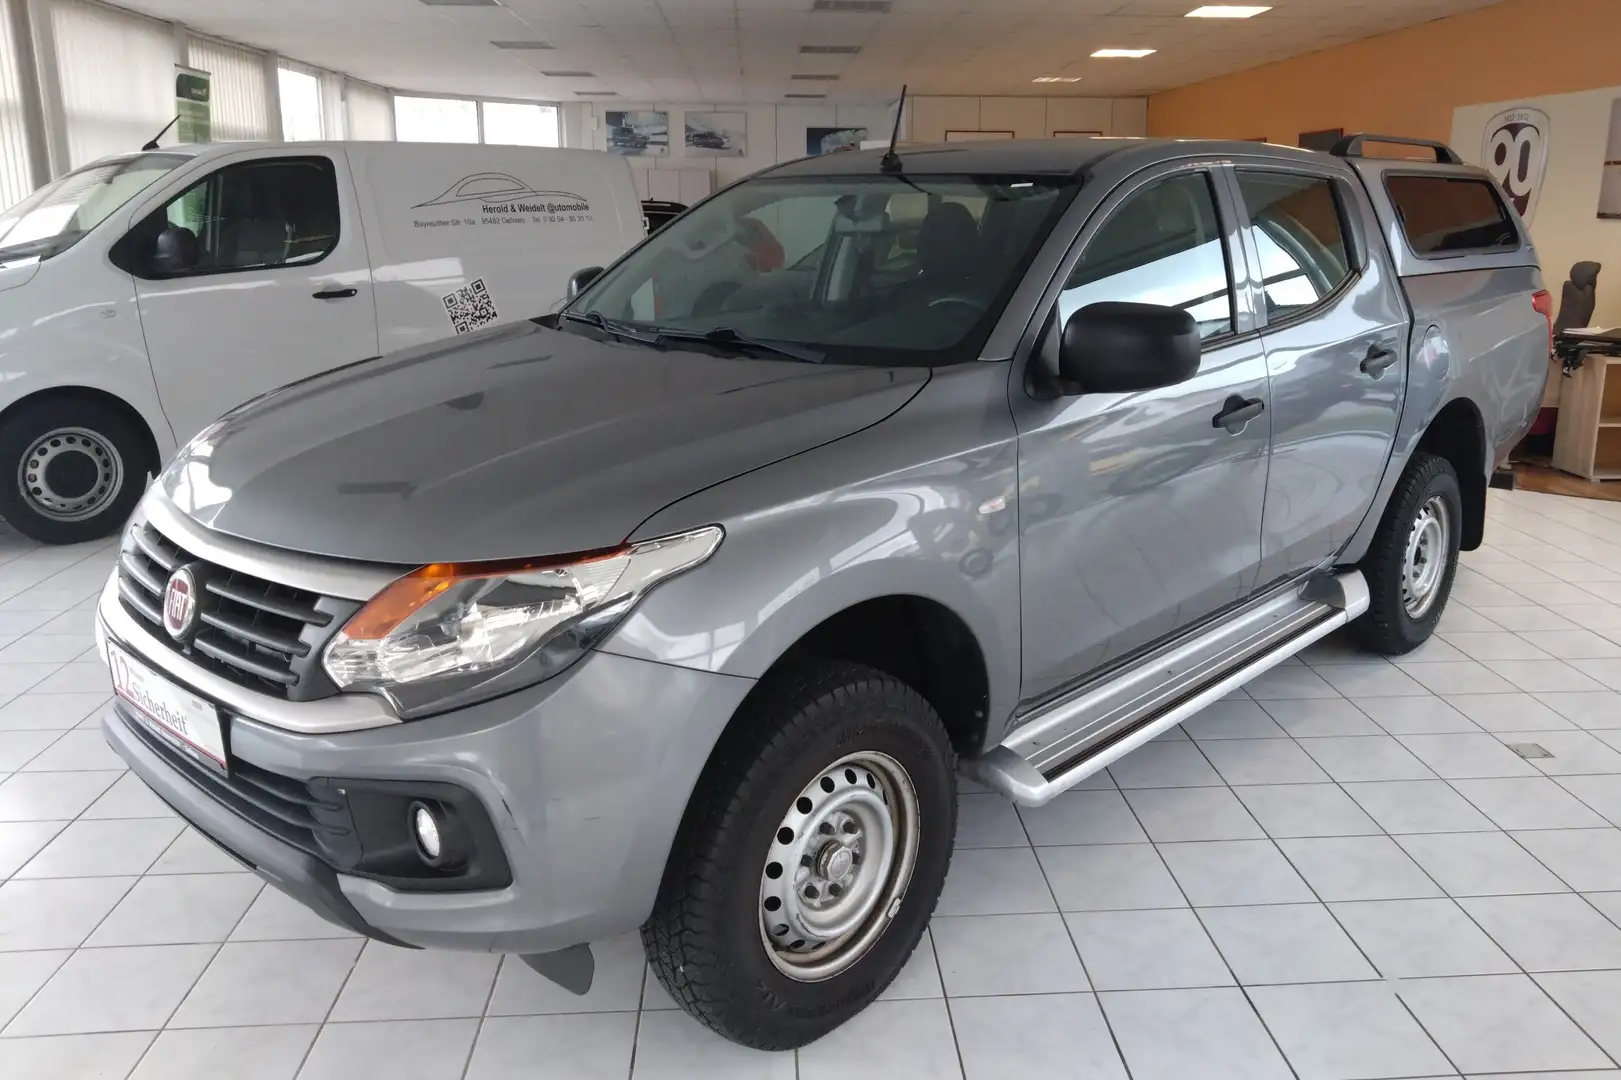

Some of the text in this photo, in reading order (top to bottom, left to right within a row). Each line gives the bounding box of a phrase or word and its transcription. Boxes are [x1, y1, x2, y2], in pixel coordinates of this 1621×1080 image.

[482, 202, 590, 214] Herold & Weidelt @utomobile
[413, 219, 450, 229] Bayreuther
[168, 588, 188, 621] FIAT
